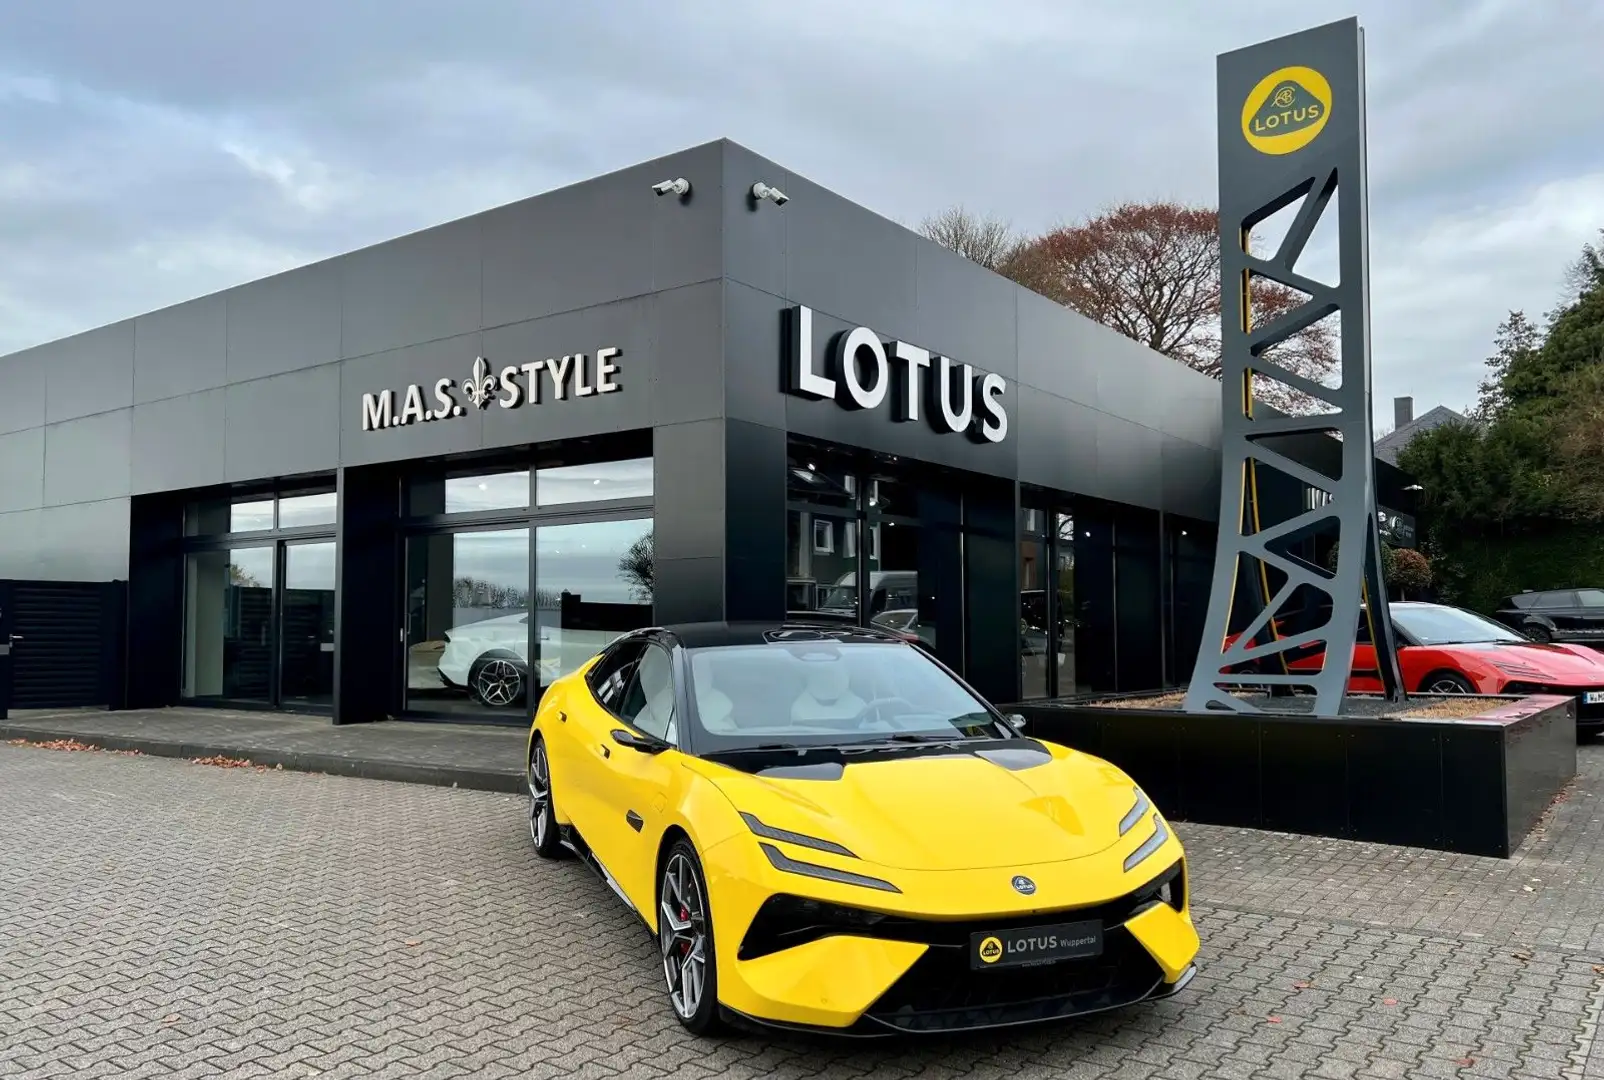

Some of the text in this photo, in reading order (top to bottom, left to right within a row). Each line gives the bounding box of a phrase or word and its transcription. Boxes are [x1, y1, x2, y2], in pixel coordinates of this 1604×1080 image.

[1255, 104, 1319, 132] LOTUS
[797, 304, 1008, 443] LOTUS
[362, 347, 617, 430] M.A.S. STYLE
[982, 948, 1000, 956] LOTUS
[1007, 936, 1097, 953] LOTUS Wuppertal
